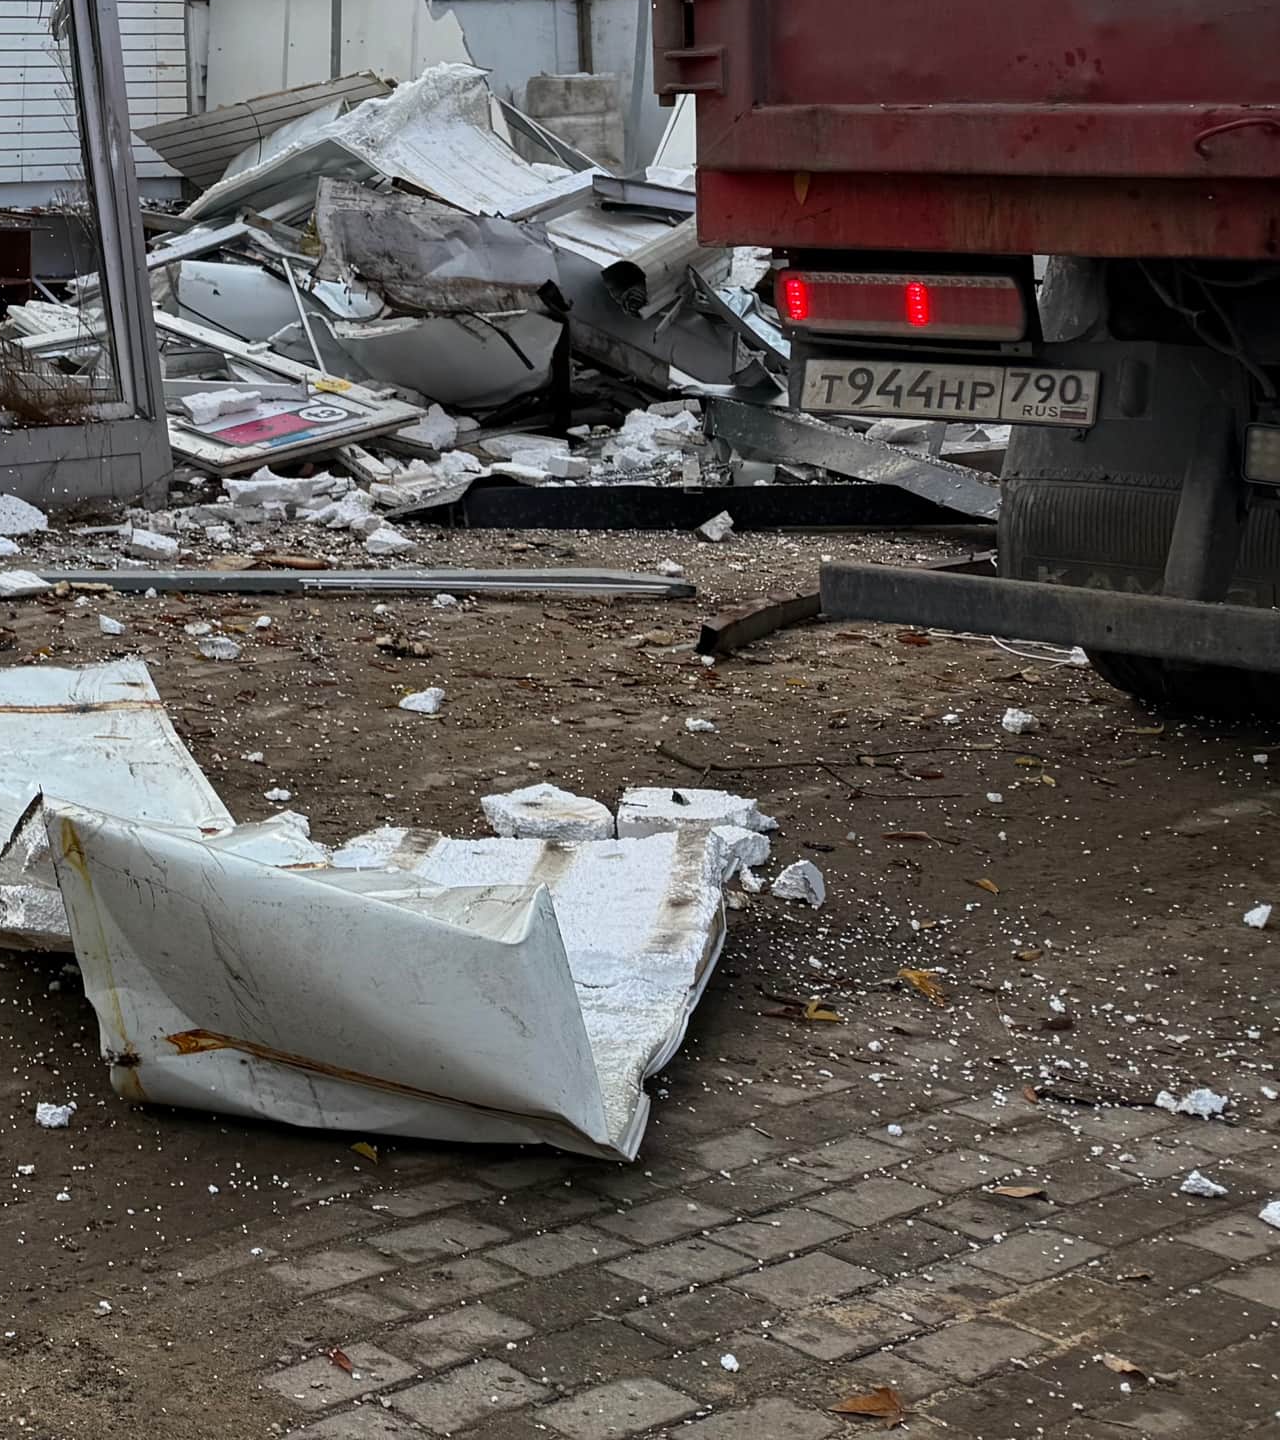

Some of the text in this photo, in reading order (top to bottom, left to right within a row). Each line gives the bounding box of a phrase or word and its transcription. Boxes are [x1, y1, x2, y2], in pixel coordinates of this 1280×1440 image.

[820, 367, 1083, 411] Т944НР 790
[1022, 405, 1058, 417] RUS
